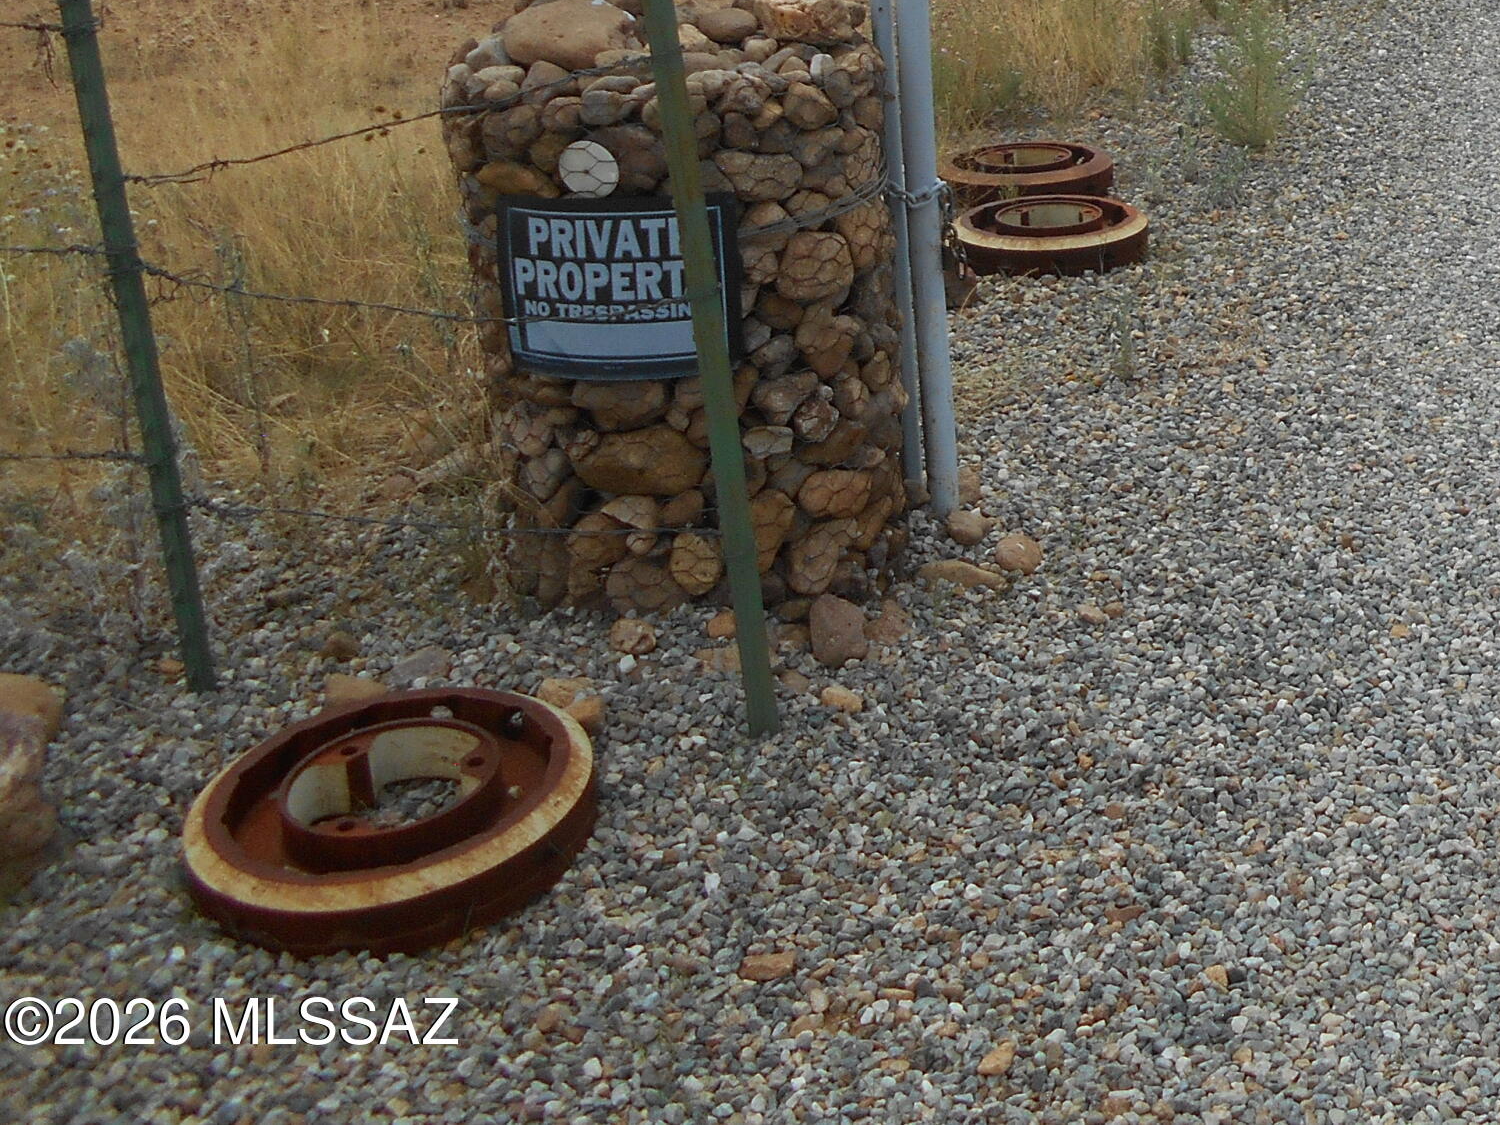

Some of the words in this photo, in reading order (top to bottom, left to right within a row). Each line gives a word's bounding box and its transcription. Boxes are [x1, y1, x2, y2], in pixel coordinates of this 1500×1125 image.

[514, 257, 686, 301] PROPERT
[525, 299, 550, 316] NO
[555, 302, 692, 320] TRESPASSIN
